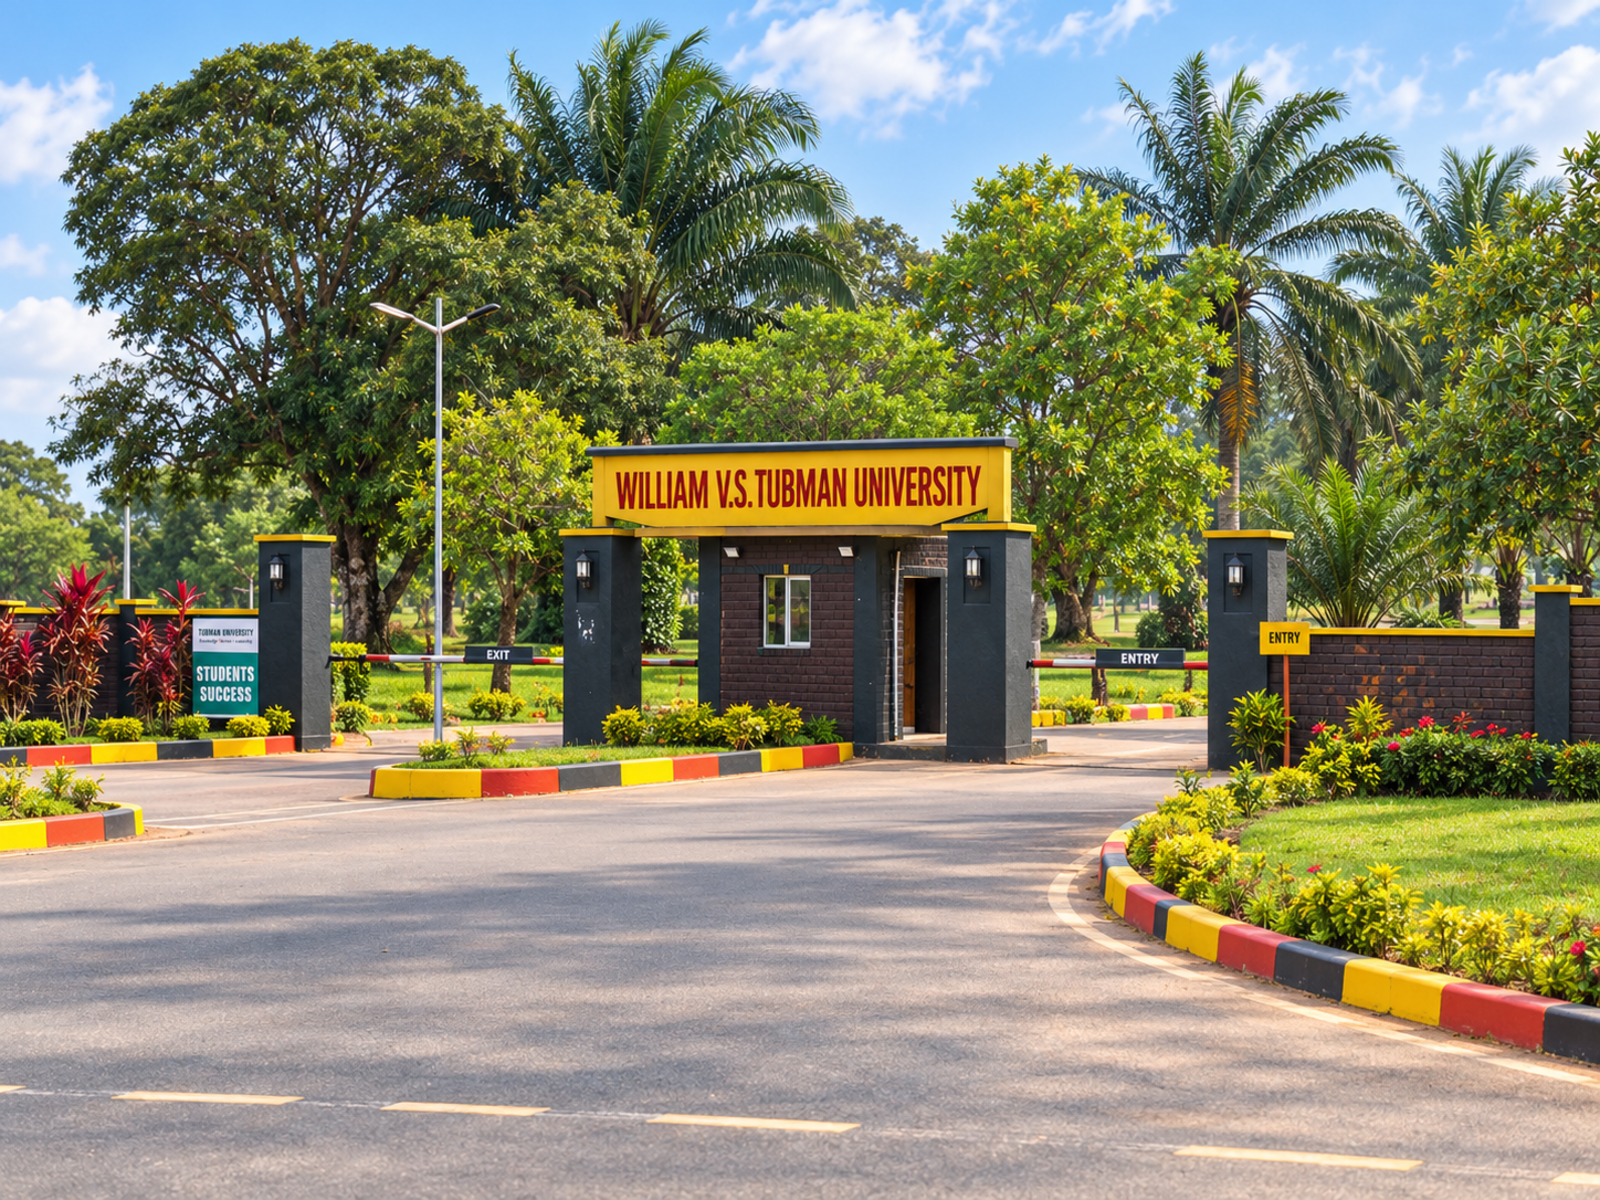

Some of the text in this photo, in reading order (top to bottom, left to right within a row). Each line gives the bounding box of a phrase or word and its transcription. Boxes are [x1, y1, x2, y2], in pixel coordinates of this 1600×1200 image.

[615, 471, 709, 510] WILLIAM
[853, 465, 982, 507] UNIVERSITY
[222, 628, 254, 636] UNIVERSITY
[1268, 631, 1301, 644] ENTRY
[487, 649, 510, 660] EXIT
[1120, 652, 1159, 665] ENTRY
[196, 665, 255, 682] STUDENTS
[200, 686, 252, 702] SUCCESS
